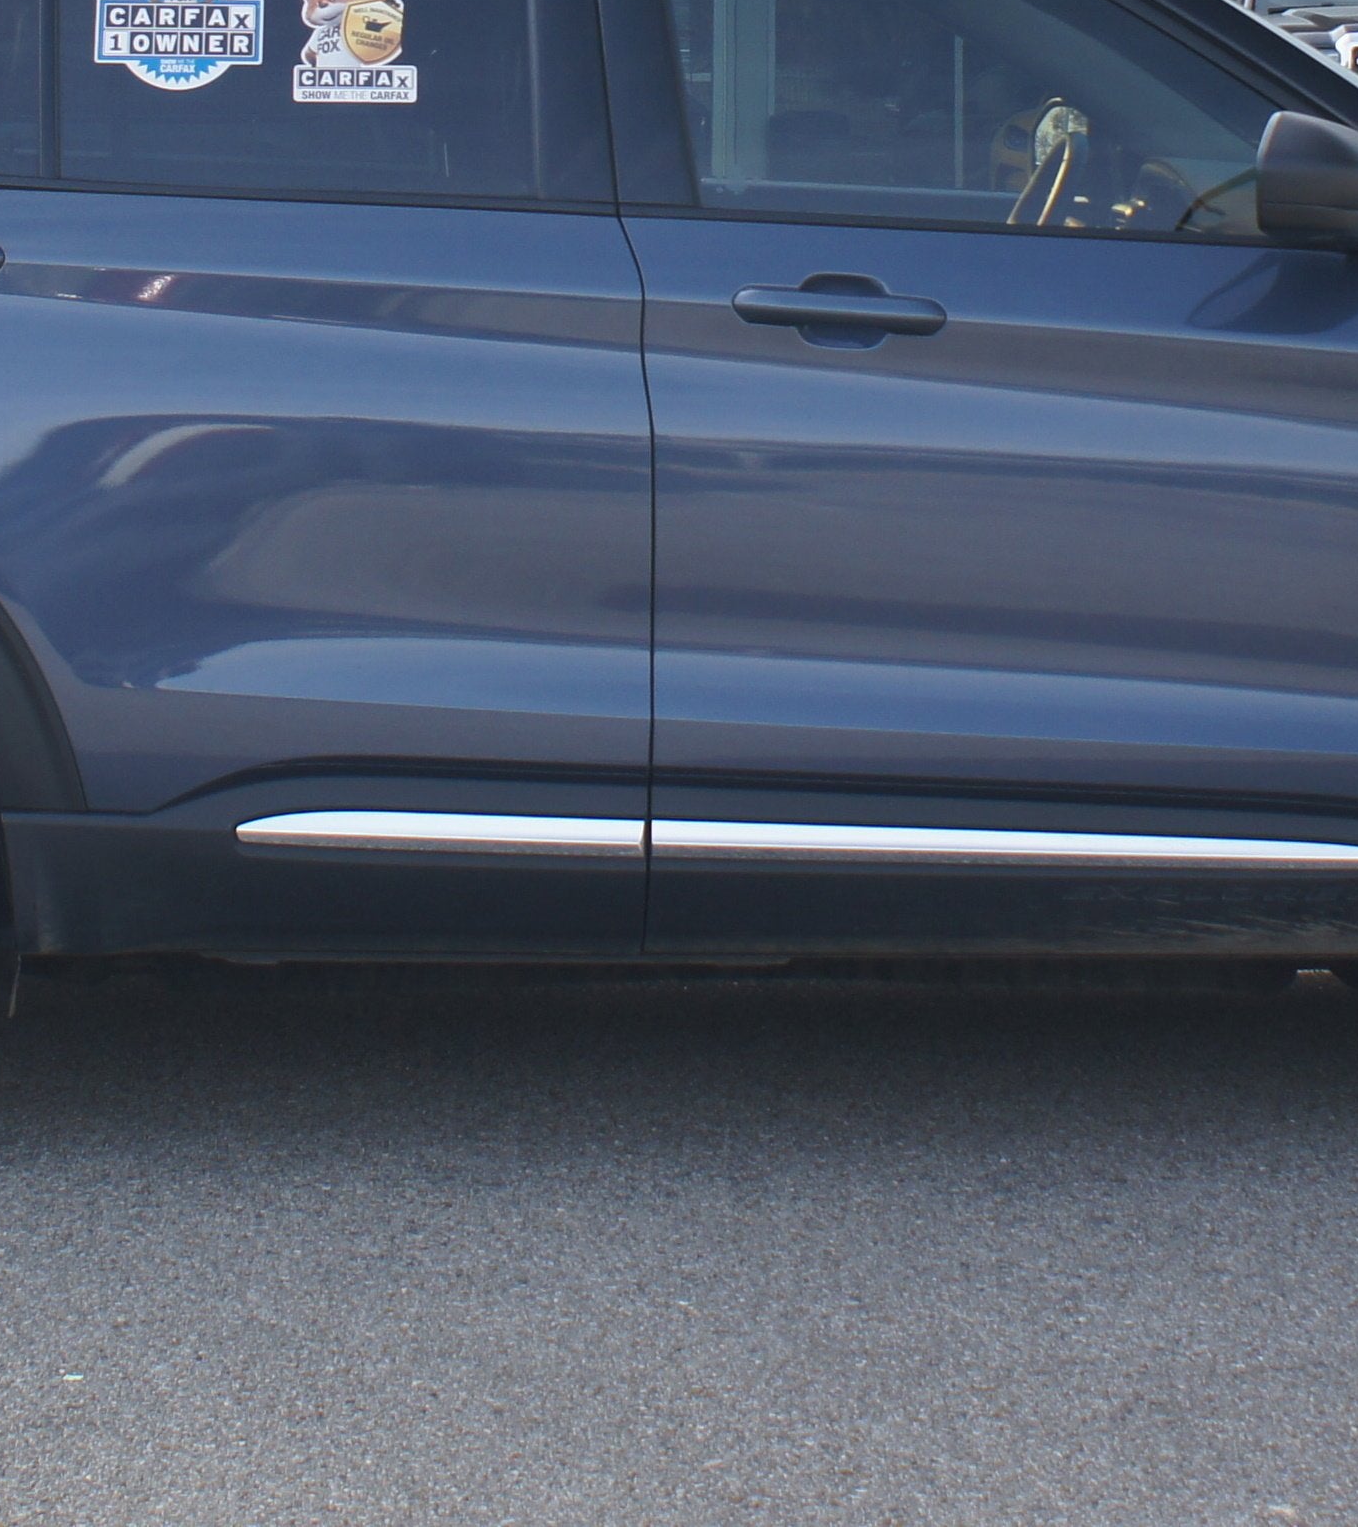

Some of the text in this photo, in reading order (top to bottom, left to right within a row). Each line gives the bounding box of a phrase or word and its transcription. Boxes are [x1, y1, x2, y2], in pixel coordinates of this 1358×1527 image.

[109, 7, 249, 29] CARFAX
[317, 26, 340, 41] CAR
[110, 33, 249, 54] 1 OWNER
[317, 39, 341, 54] FOX
[160, 64, 195, 73] CARFAX
[300, 71, 410, 88] CARFAX
[301, 90, 410, 100] SHOW ME THE CARFAX
